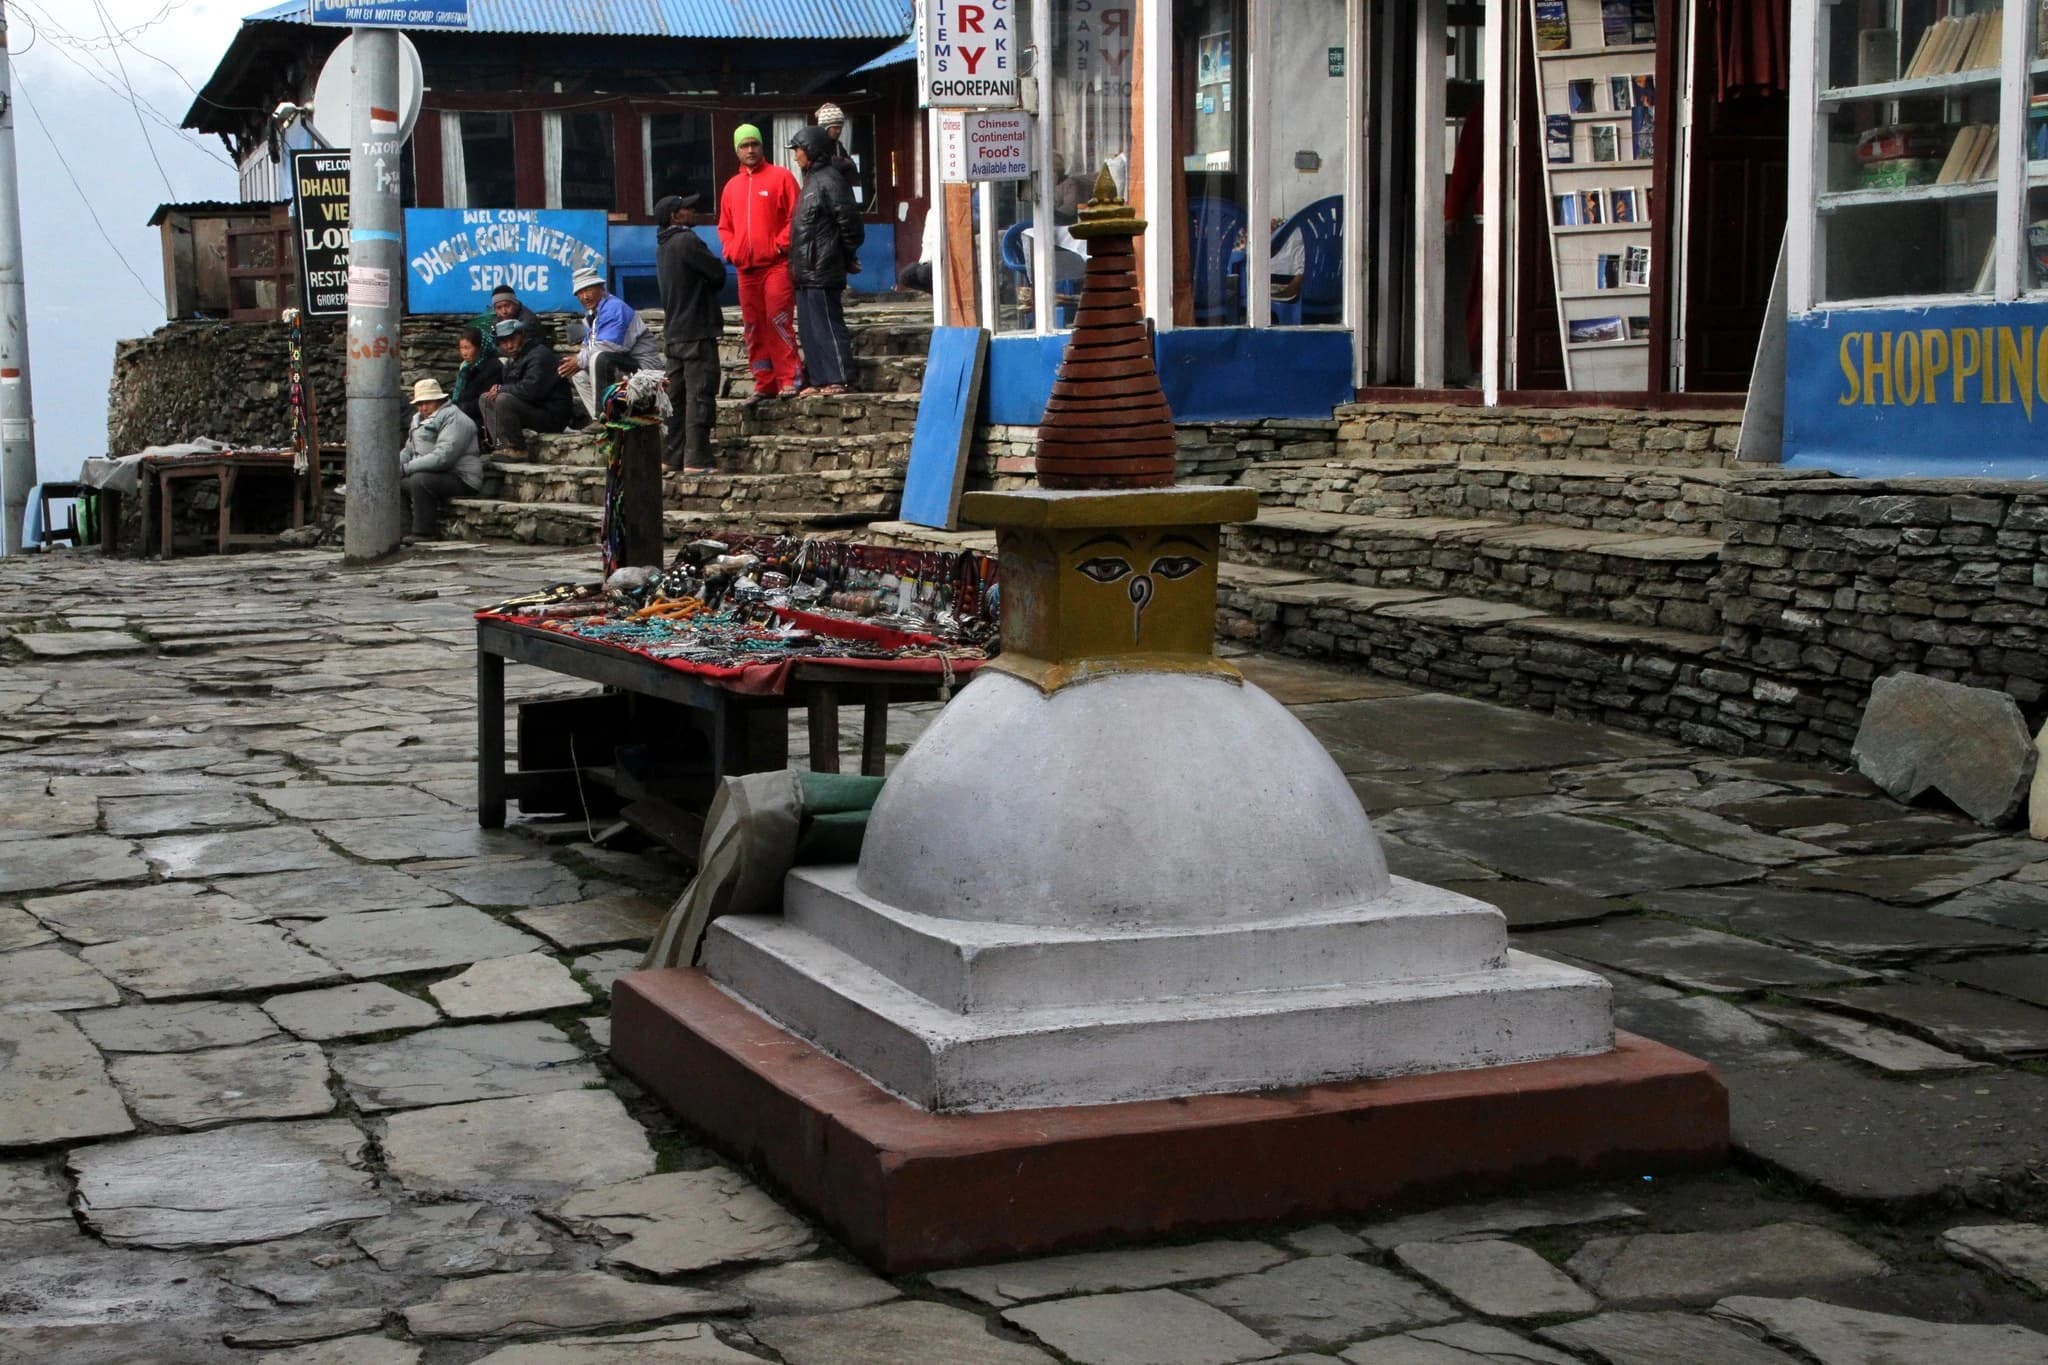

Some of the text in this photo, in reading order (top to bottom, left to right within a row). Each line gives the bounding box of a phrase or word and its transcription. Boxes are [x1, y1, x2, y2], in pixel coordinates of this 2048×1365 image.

[993, 0, 1008, 69] CAKE
[931, 80, 1014, 97] GHOREPANI
[978, 119, 1019, 129] Chinese
[971, 131, 1026, 143] Continental
[979, 146, 1019, 158] Food's
[971, 161, 1026, 175] Available here
[463, 210, 539, 224] WEL COME
[469, 264, 549, 292] SERVICE
